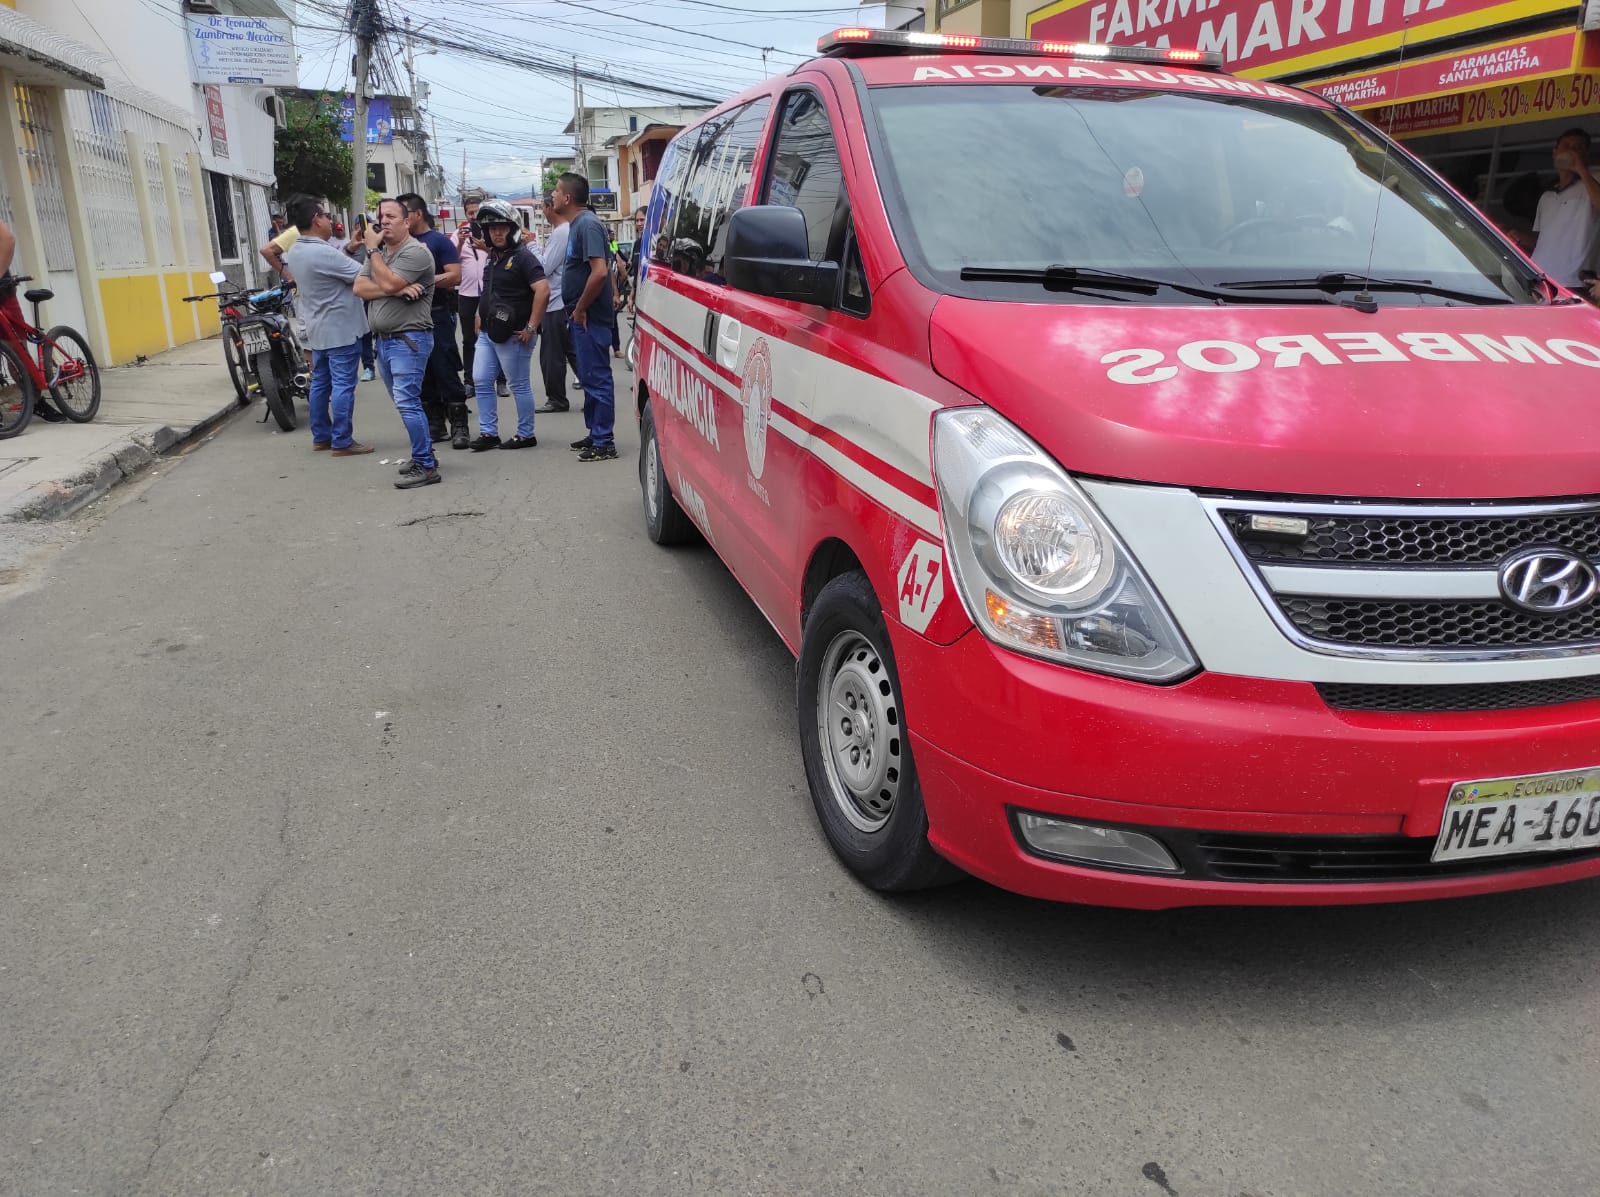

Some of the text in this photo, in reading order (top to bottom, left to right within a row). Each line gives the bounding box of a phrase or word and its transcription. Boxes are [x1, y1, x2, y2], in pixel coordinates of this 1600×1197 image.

[195, 28, 243, 40] Zambrano
[224, 17, 268, 30] Leonardo
[1438, 56, 1539, 85] SANTA MARTHA
[1453, 47, 1527, 71] FARMACIAS
[1322, 78, 1377, 97] FARMACIAS
[1344, 86, 1387, 102] MARTHA
[1379, 96, 1459, 123] SANTA MARTHA
[1467, 91, 1495, 123] 20%
[1499, 86, 1529, 118] 30%
[1533, 79, 1566, 112] 40%
[647, 341, 720, 453] AMBULANCIA
[900, 553, 940, 613] A-7
[1512, 776, 1585, 798] ECUADOR
